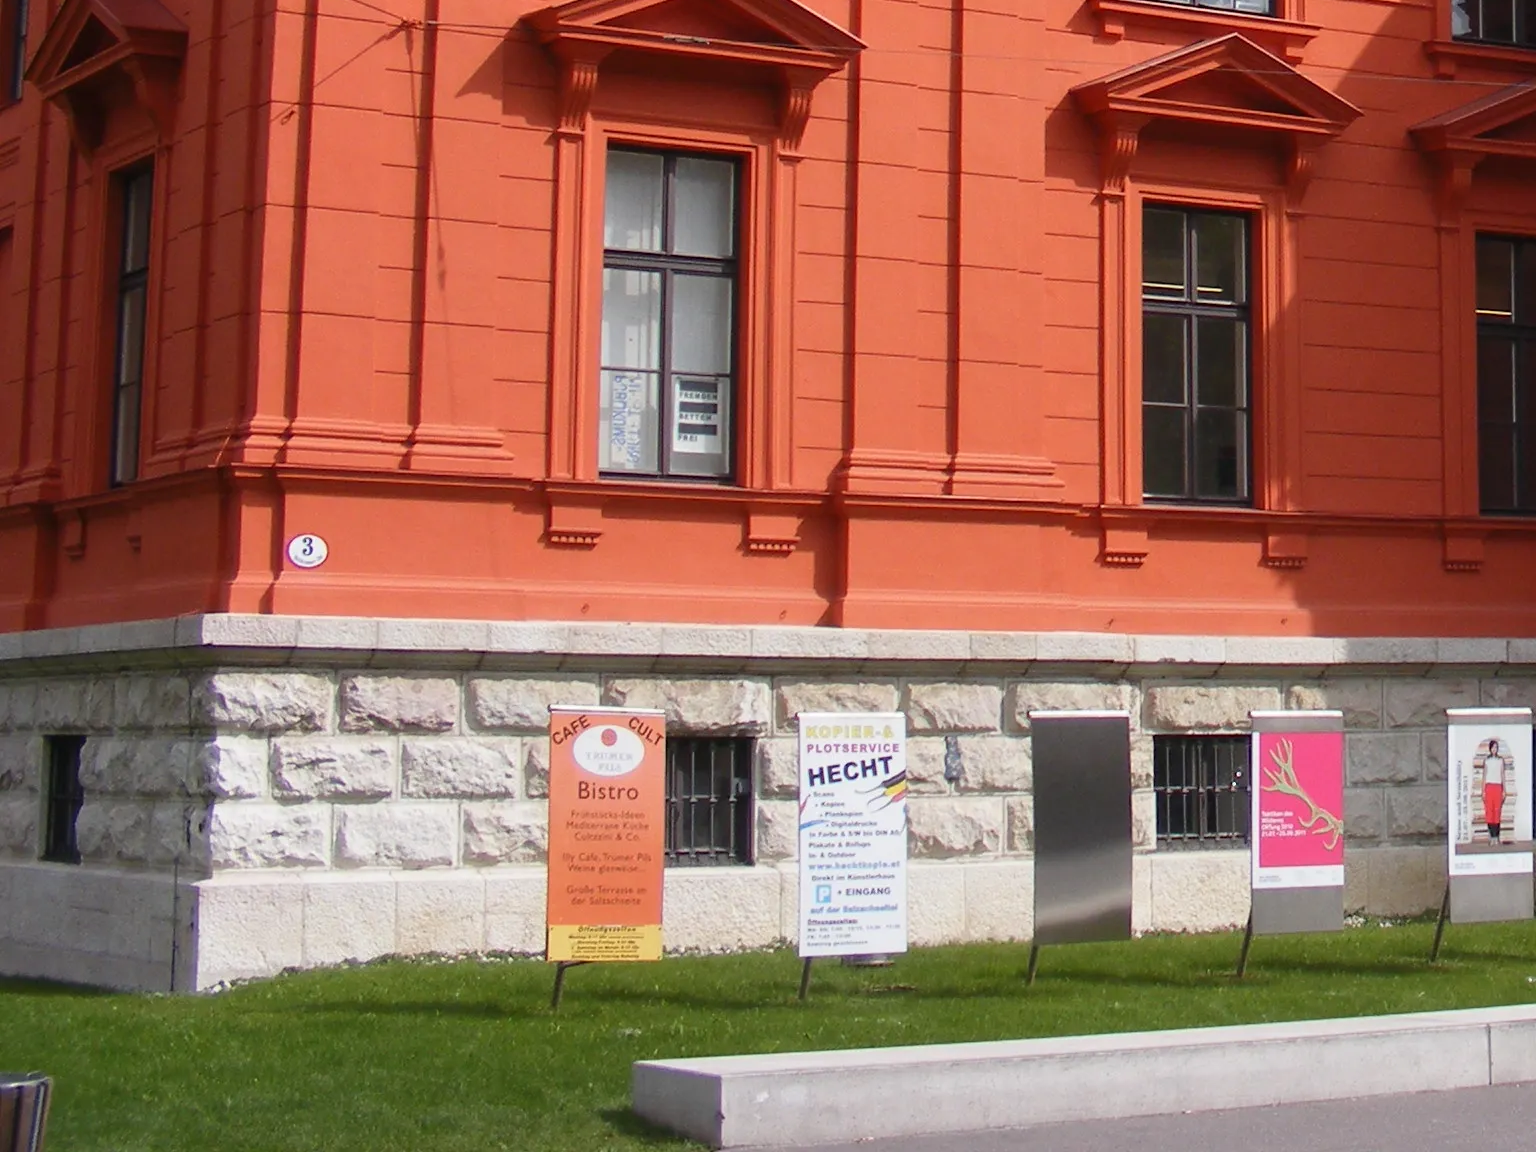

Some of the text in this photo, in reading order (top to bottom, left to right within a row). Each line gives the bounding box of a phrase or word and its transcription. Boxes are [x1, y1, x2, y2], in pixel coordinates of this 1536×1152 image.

[678, 433, 699, 442] FREI
[302, 537, 314, 556] 3
[628, 717, 664, 746] CULT
[807, 743, 900, 754] PLOTSERVICE
[808, 755, 892, 787] HECHT
[578, 780, 639, 801] Bistro
[845, 887, 891, 897] EINGANG
